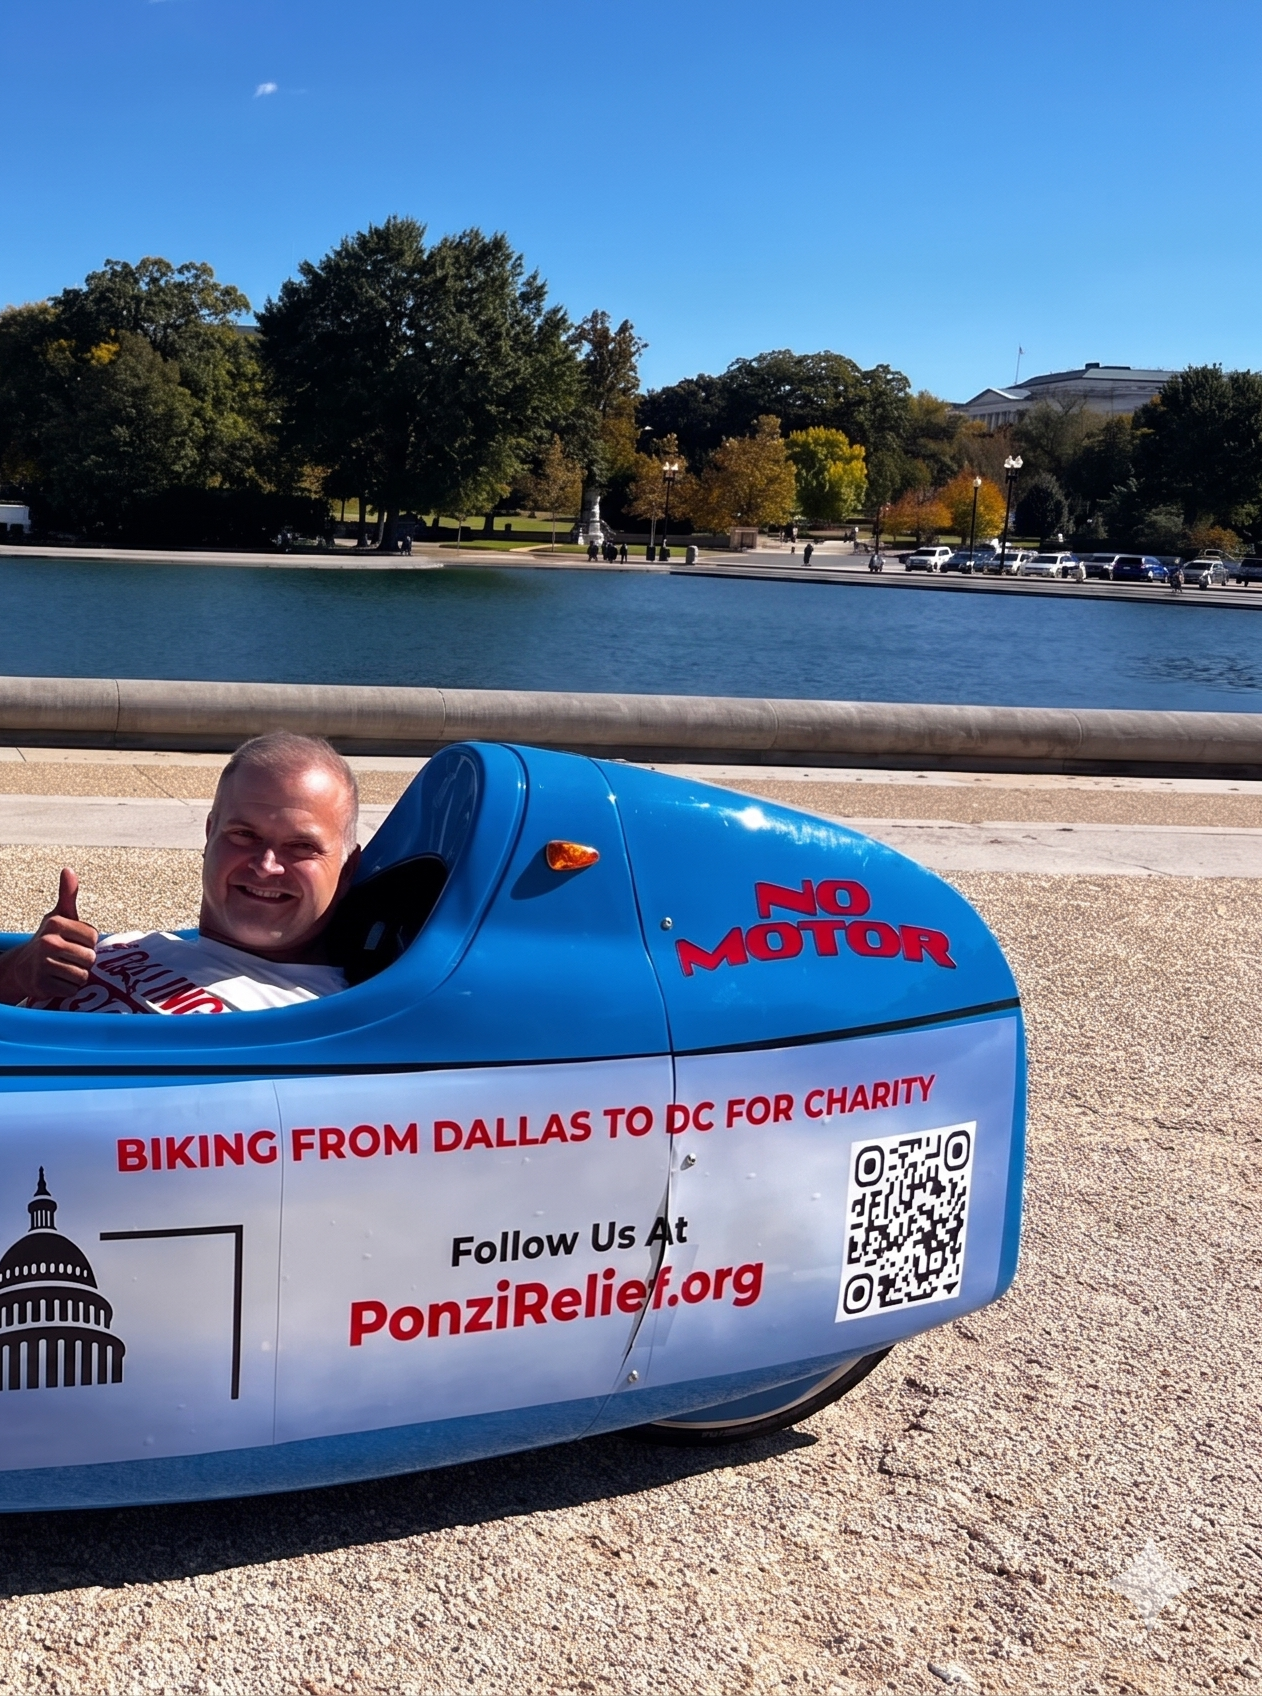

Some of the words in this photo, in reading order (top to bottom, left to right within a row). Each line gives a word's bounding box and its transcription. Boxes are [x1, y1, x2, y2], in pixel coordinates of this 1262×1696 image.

[755, 879, 871, 918] NO
[675, 920, 957, 977] MOTOR
[116, 1129, 278, 1173] BIKING
[291, 1122, 419, 1162] FROM
[433, 1110, 592, 1153] DALLAS
[603, 1105, 654, 1139] TO
[665, 1101, 715, 1135] DC
[726, 1093, 794, 1128] FOR
[804, 1074, 936, 1119] CHARITY
[451, 1229, 580, 1267] Follow
[591, 1221, 636, 1252] Us
[645, 1215, 689, 1247] At
[349, 1261, 764, 1347] PonziRelief.org
